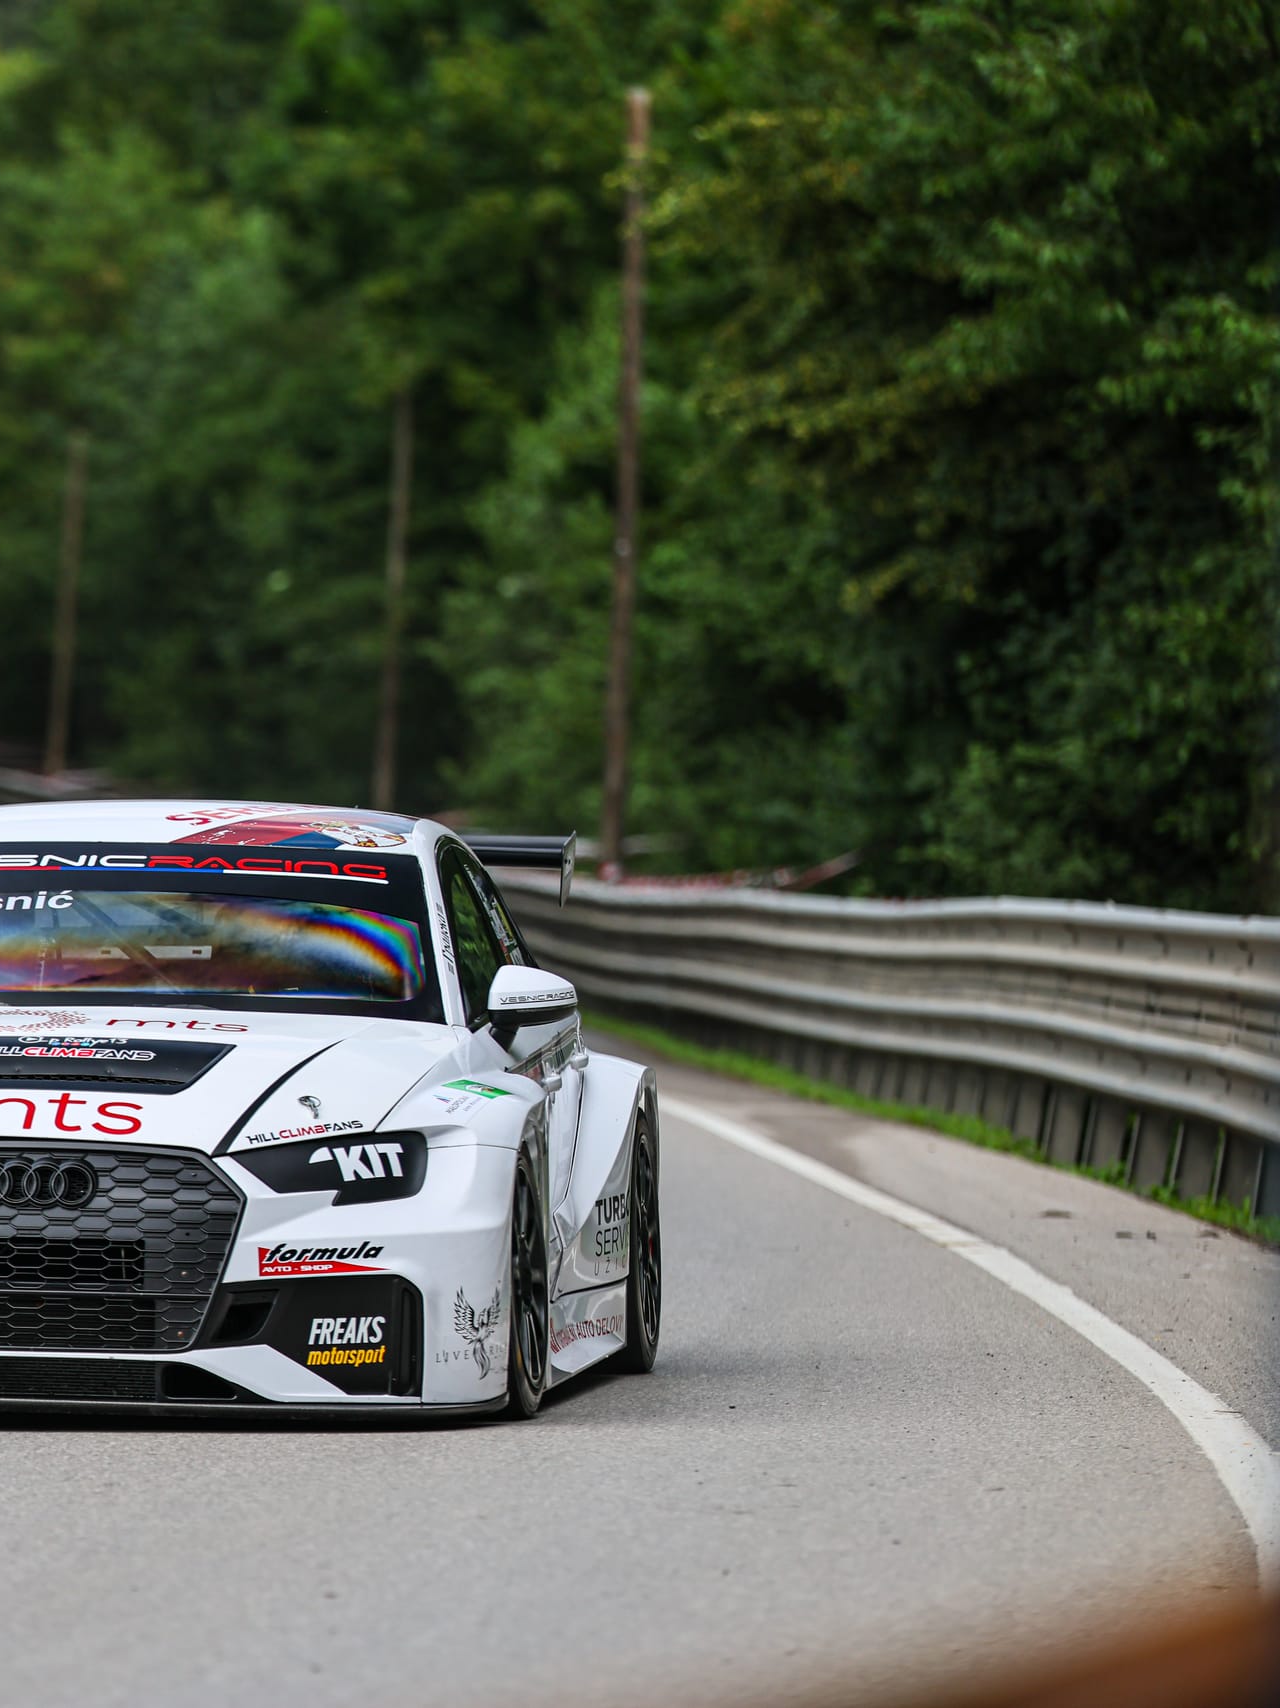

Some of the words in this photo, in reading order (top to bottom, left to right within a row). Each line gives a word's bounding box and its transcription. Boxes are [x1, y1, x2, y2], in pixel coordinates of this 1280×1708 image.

[106, 1019, 248, 1033] mts
[245, 1120, 364, 1145] HILLCLIMBFANS
[332, 1142, 404, 1183] KIT
[262, 1241, 385, 1263] formula
[308, 1316, 386, 1345] FREAKS
[576, 1320, 594, 1338] AUTO
[306, 1345, 386, 1367] motorsport
